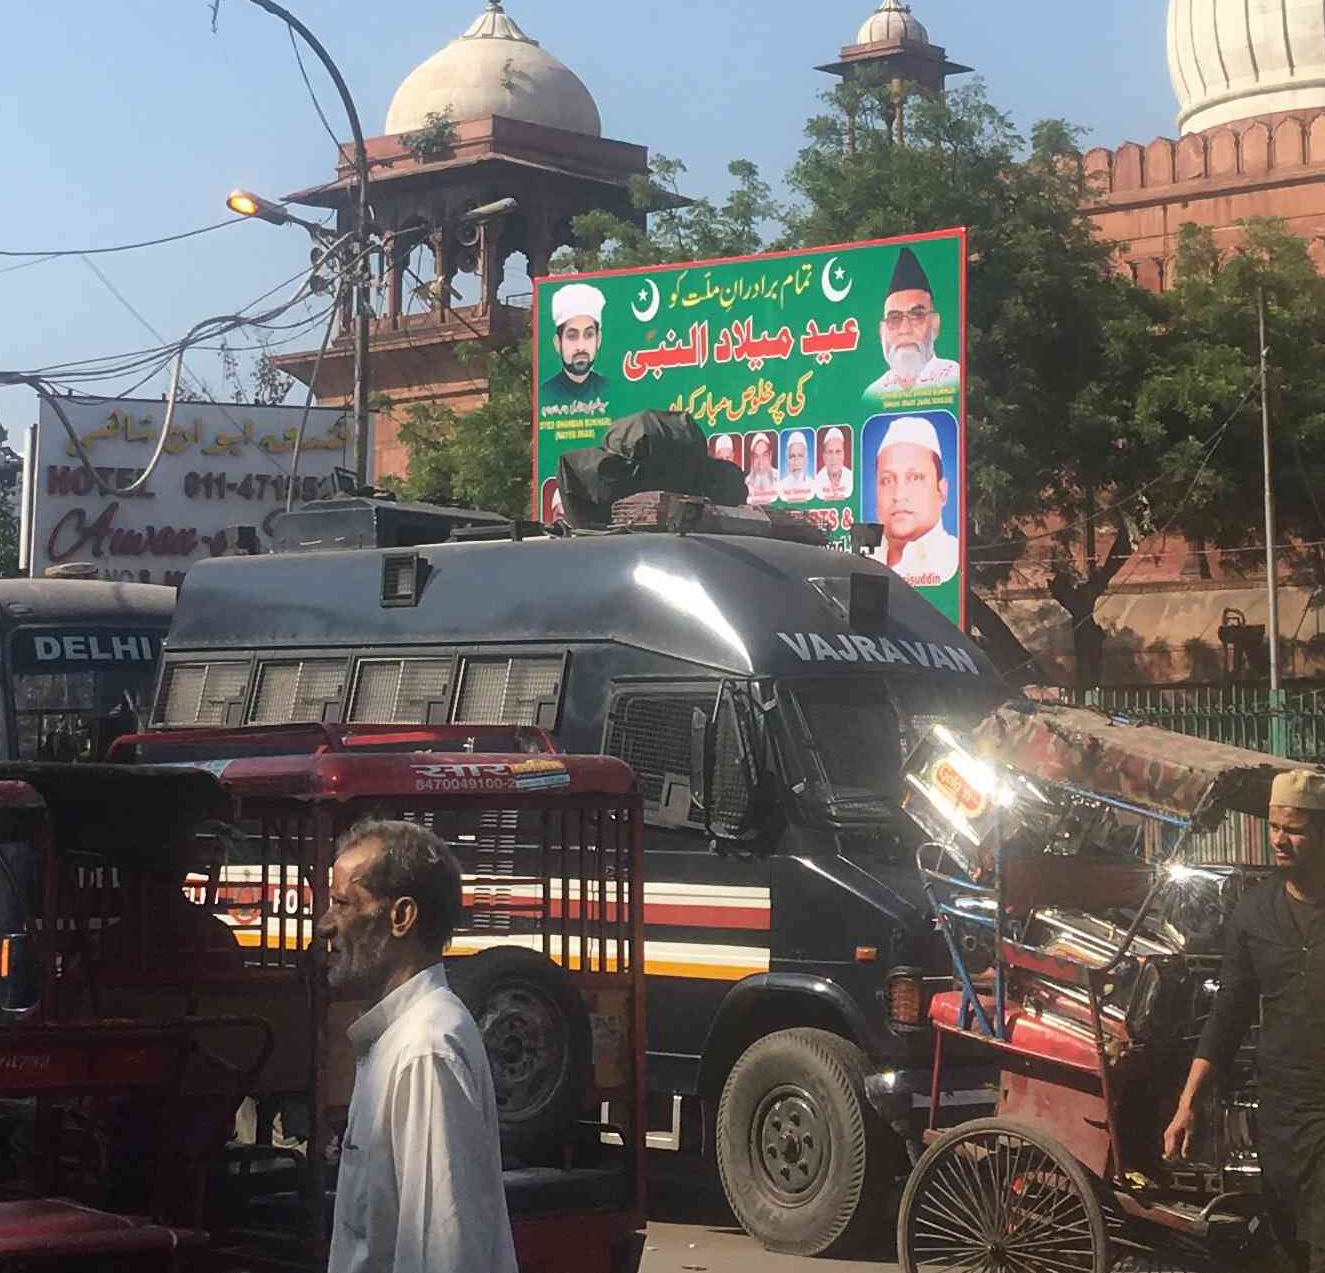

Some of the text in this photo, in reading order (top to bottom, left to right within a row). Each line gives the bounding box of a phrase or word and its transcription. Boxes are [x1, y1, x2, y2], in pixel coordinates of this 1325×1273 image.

[714, 315, 795, 371] میلاد
[800, 317, 860, 365] عید
[47, 465, 155, 498] HOTEL
[34, 636, 154, 660] DELHI
[777, 632, 979, 675] VAJRA VAN
[410, 763, 512, 778] सार
[416, 778, 516, 791] 8470049100-2
